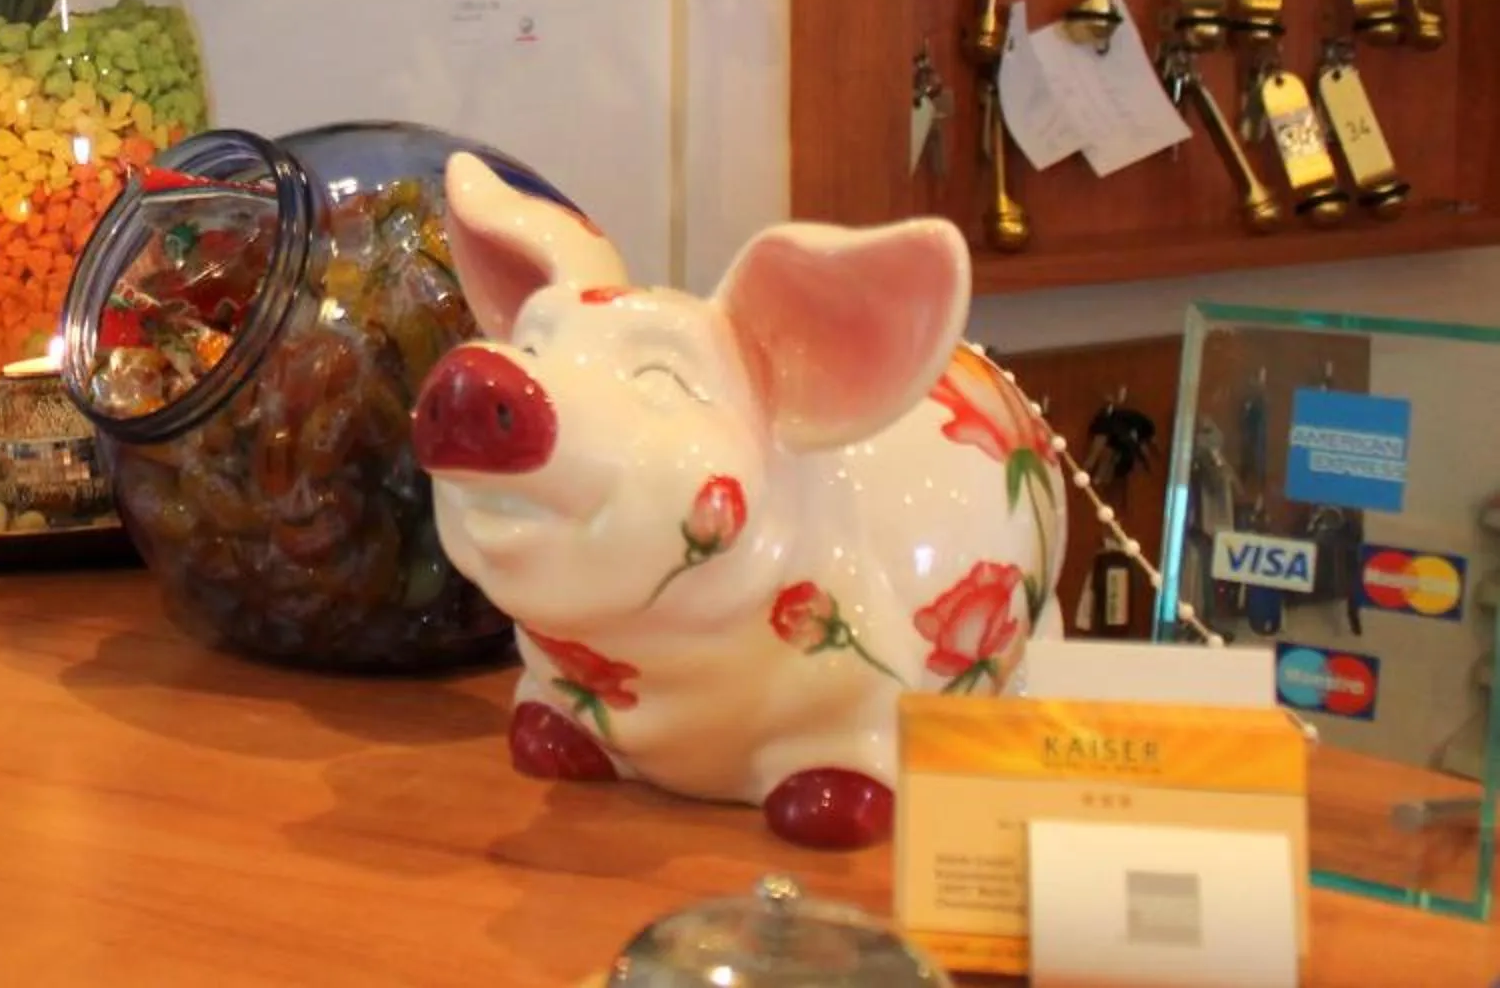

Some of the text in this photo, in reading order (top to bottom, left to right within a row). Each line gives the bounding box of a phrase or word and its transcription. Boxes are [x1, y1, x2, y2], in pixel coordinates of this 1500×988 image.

[1292, 427, 1403, 457] AMERICAN
[1224, 544, 1310, 581] VISA
[1044, 736, 1159, 763] KAISER
